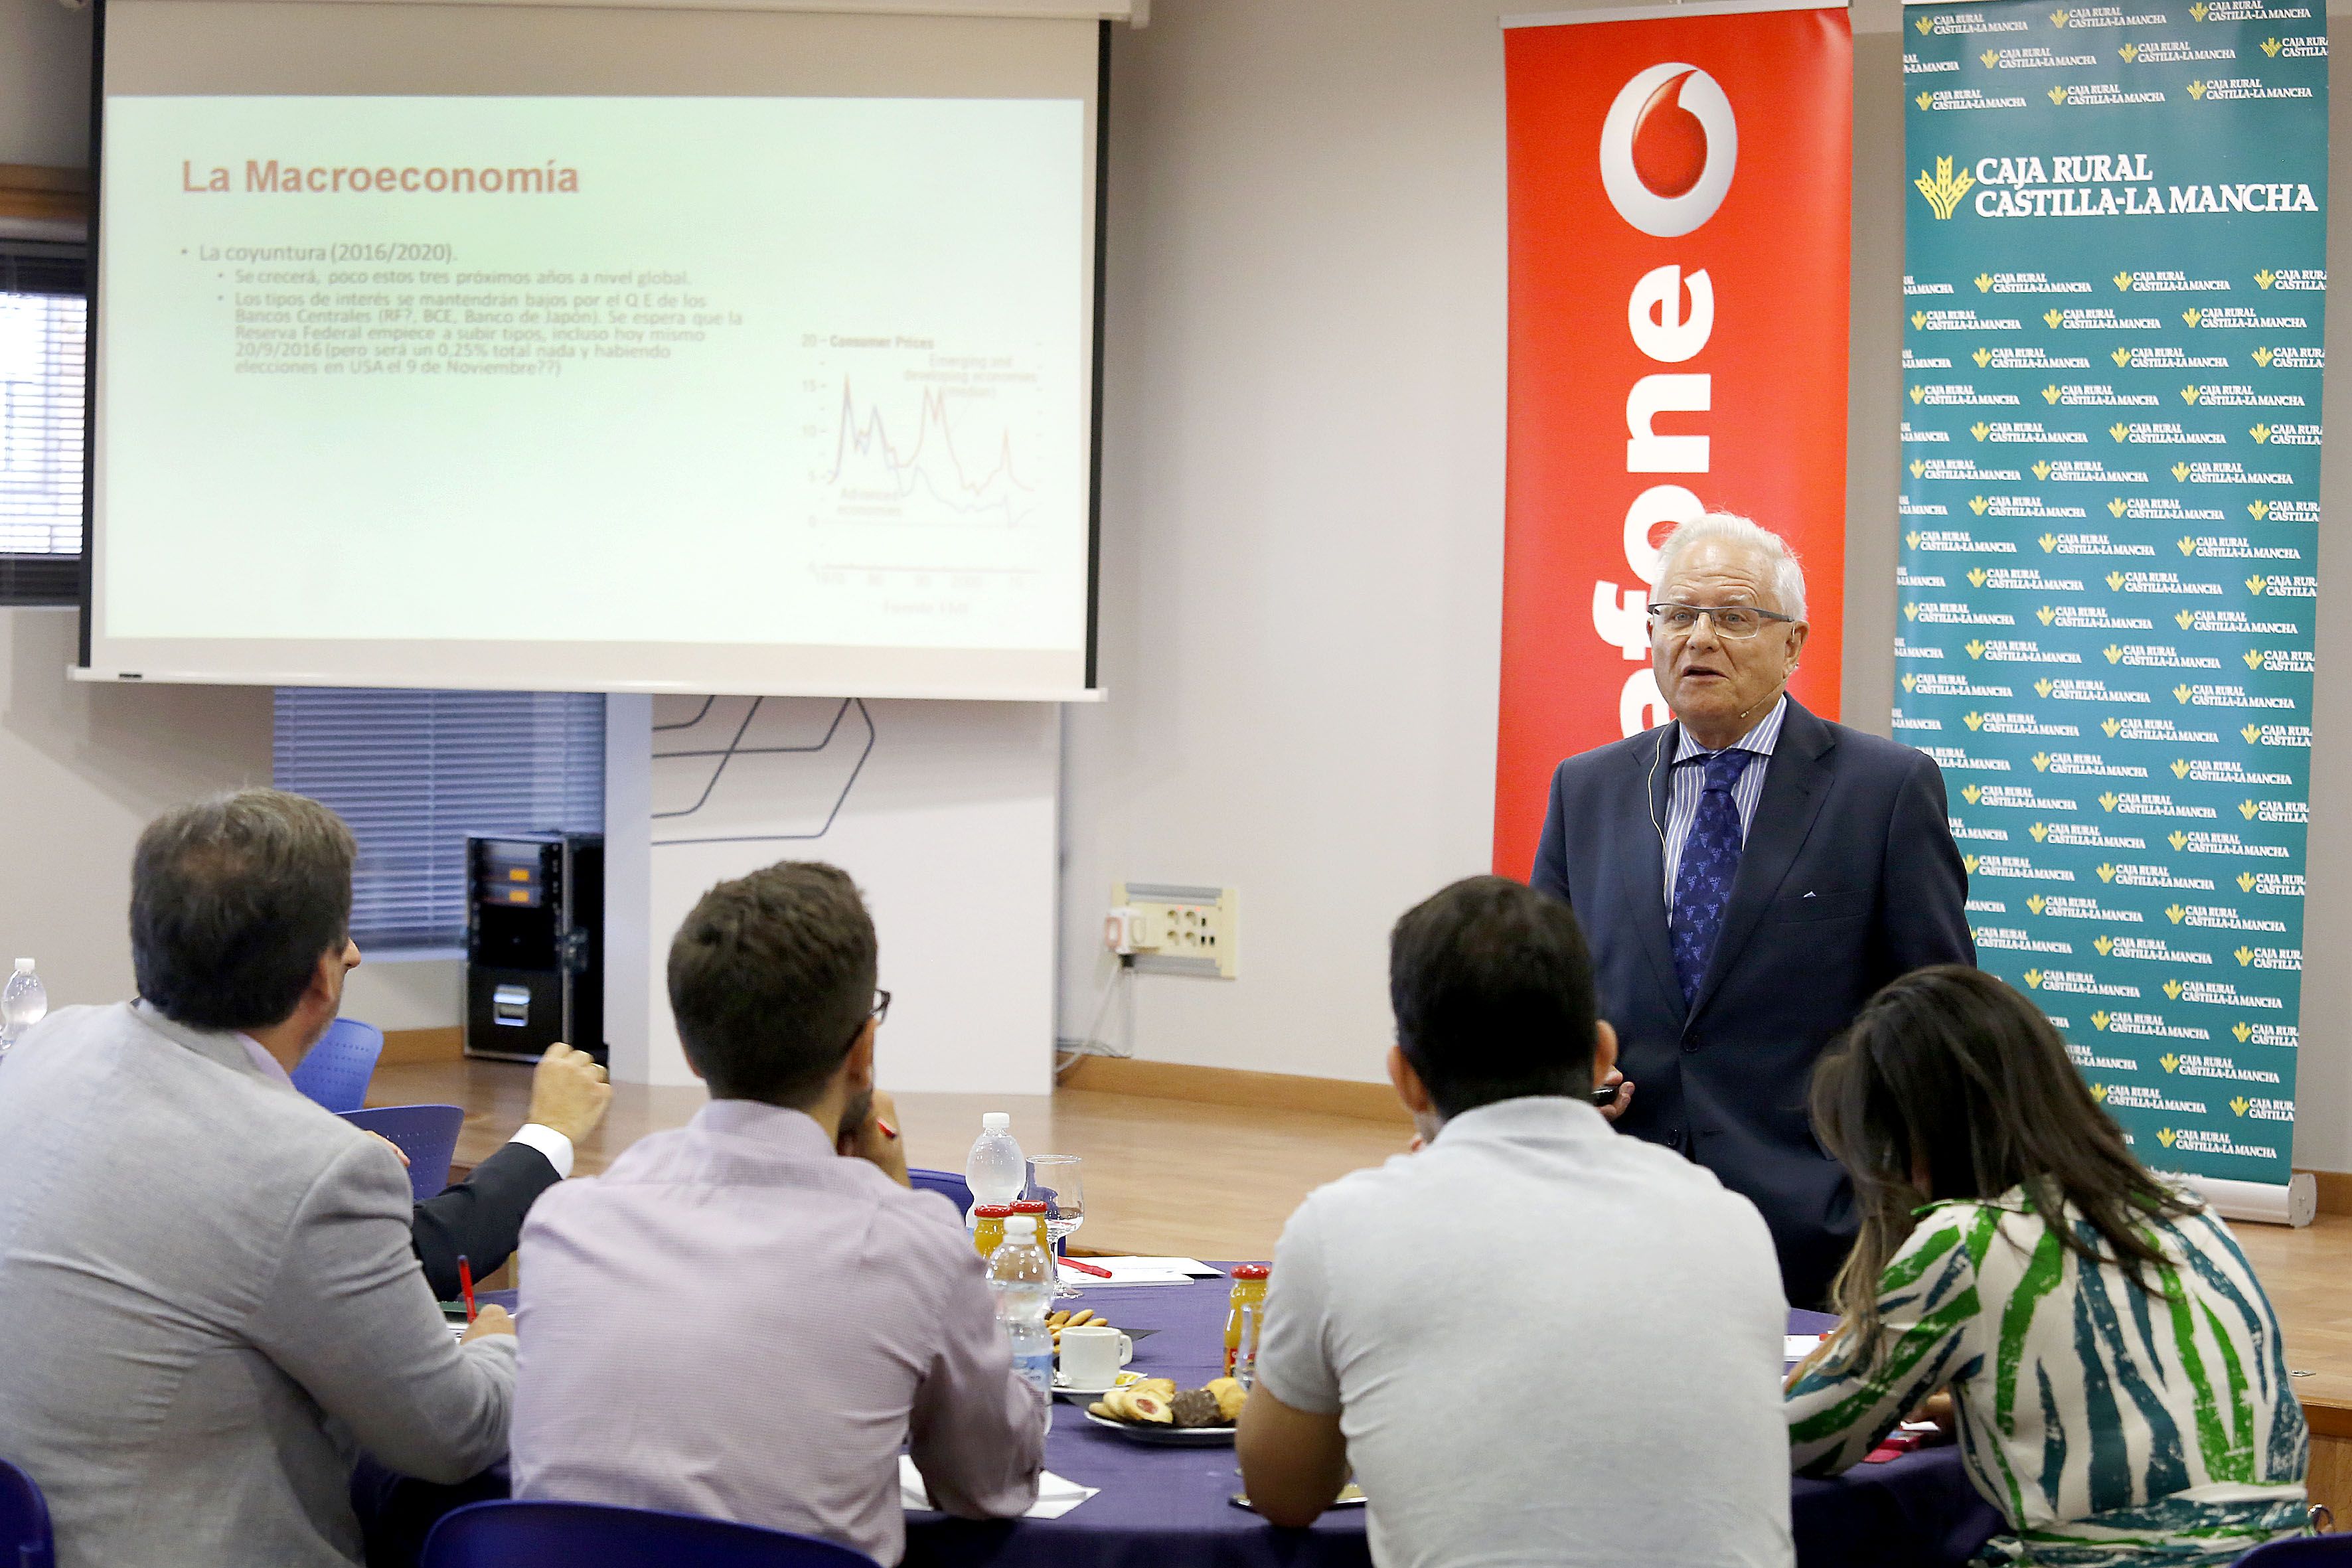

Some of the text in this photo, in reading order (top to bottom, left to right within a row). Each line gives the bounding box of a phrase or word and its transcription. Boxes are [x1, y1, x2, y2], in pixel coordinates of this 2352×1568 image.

[2069, 7, 2122, 18] CAJA RURAL
[2123, 14, 2167, 25] MANCHA
[1998, 46, 2051, 58] CAJA RURAL
[2137, 40, 2190, 52] CAJA RURAL
[2053, 54, 2096, 67] MANCHA
[2192, 48, 2236, 60] MANCHA
[2207, 78, 2262, 90] CAJA RURAL
[1932, 88, 1982, 100] CAJA RURAL
[2266, 87, 2312, 98] MANCHA
[1984, 96, 2027, 108] MANCHA
[183, 159, 580, 193] La Macroeconomía
[1976, 153, 2153, 190] CAJA RURAL
[1974, 183, 2319, 218] CASTILLA-LA MANCHA
[199, 243, 220, 262] La
[226, 245, 326, 266] coyuntura
[235, 271, 254, 284] Se
[328, 274, 368, 287] poco
[372, 272, 414, 285] estos
[420, 272, 449, 285] tres
[457, 273, 531, 287] próximos
[537, 273, 574, 285] años
[580, 275, 589, 285] a
[594, 272, 632, 285] nivel
[2132, 270, 2185, 281] CAJA RURAL
[2187, 279, 2231, 290] MANCHA
[235, 293, 262, 306] Los
[266, 293, 305, 309] tipos
[310, 293, 330, 306] de
[336, 294, 390, 306] interés
[398, 296, 414, 307] se
[420, 293, 518, 307] mantendrán
[526, 293, 567, 309] bajos
[574, 297, 599, 310] por
[606, 294, 620, 307] el
[657, 294, 677, 307] de
[684, 294, 706, 307] los
[235, 309, 291, 323] Bancos
[297, 310, 372, 323] Centrales
[465, 311, 513, 324] Banco
[519, 311, 539, 324] de
[609, 311, 627, 325] Se
[633, 314, 685, 327] espera
[693, 314, 722, 327] que
[729, 311, 742, 325] la
[2202, 307, 2256, 317] CAJA RURAL
[2260, 317, 2307, 327] MANCHA
[235, 327, 297, 340] Reserva
[303, 327, 362, 340] Federal
[368, 328, 435, 343] empiece
[443, 330, 451, 341] a
[457, 327, 495, 341] subir
[553, 328, 608, 341] incluso
[615, 328, 644, 344] hoy
[650, 329, 705, 341] mismo
[235, 343, 322, 358] 20/9/2016
[375, 345, 406, 357] será
[414, 347, 431, 357] un
[493, 345, 530, 358] total
[537, 345, 575, 358] nada
[595, 345, 670, 358] habiendo
[235, 360, 317, 374] elecciones
[325, 364, 344, 374] en
[351, 361, 383, 374] USA
[387, 361, 401, 374] el
[406, 361, 416, 374] 9
[421, 361, 440, 374] de
[2061, 384, 2113, 396] CAJA RURAL
[2116, 394, 2159, 405] MANCHA
[1990, 422, 2043, 432] CAJA RURAL
[2044, 431, 2088, 443] MANCHA
[2189, 461, 2243, 473] CAJA RURAL
[2247, 473, 2294, 484] MANCHA
[2055, 605, 2108, 617] CAJA RURAL
[2109, 617, 2153, 629] MANCHA
[1984, 639, 2037, 652] CAJA RURAL
[2038, 651, 2082, 663] MANCHA
[2187, 831, 2240, 844] CAJA RURAL
[2244, 844, 2289, 857] MANCHA
[2115, 864, 2169, 877] CAJA RURAL
[2170, 877, 2215, 890] MANCHA
[2182, 980, 2236, 994] CAJA RURAL
[2237, 995, 2282, 1008] MANCHA
[2110, 1011, 2163, 1026] CAJA RURAL
[2165, 1026, 2209, 1040] MANCHA
[2179, 1054, 2233, 1069] CAJA RURAL
[2234, 1069, 2280, 1083] MANCHA
[2176, 1129, 2230, 1143] CAJA RURAL
[2231, 1144, 2276, 1158] MANCHA
